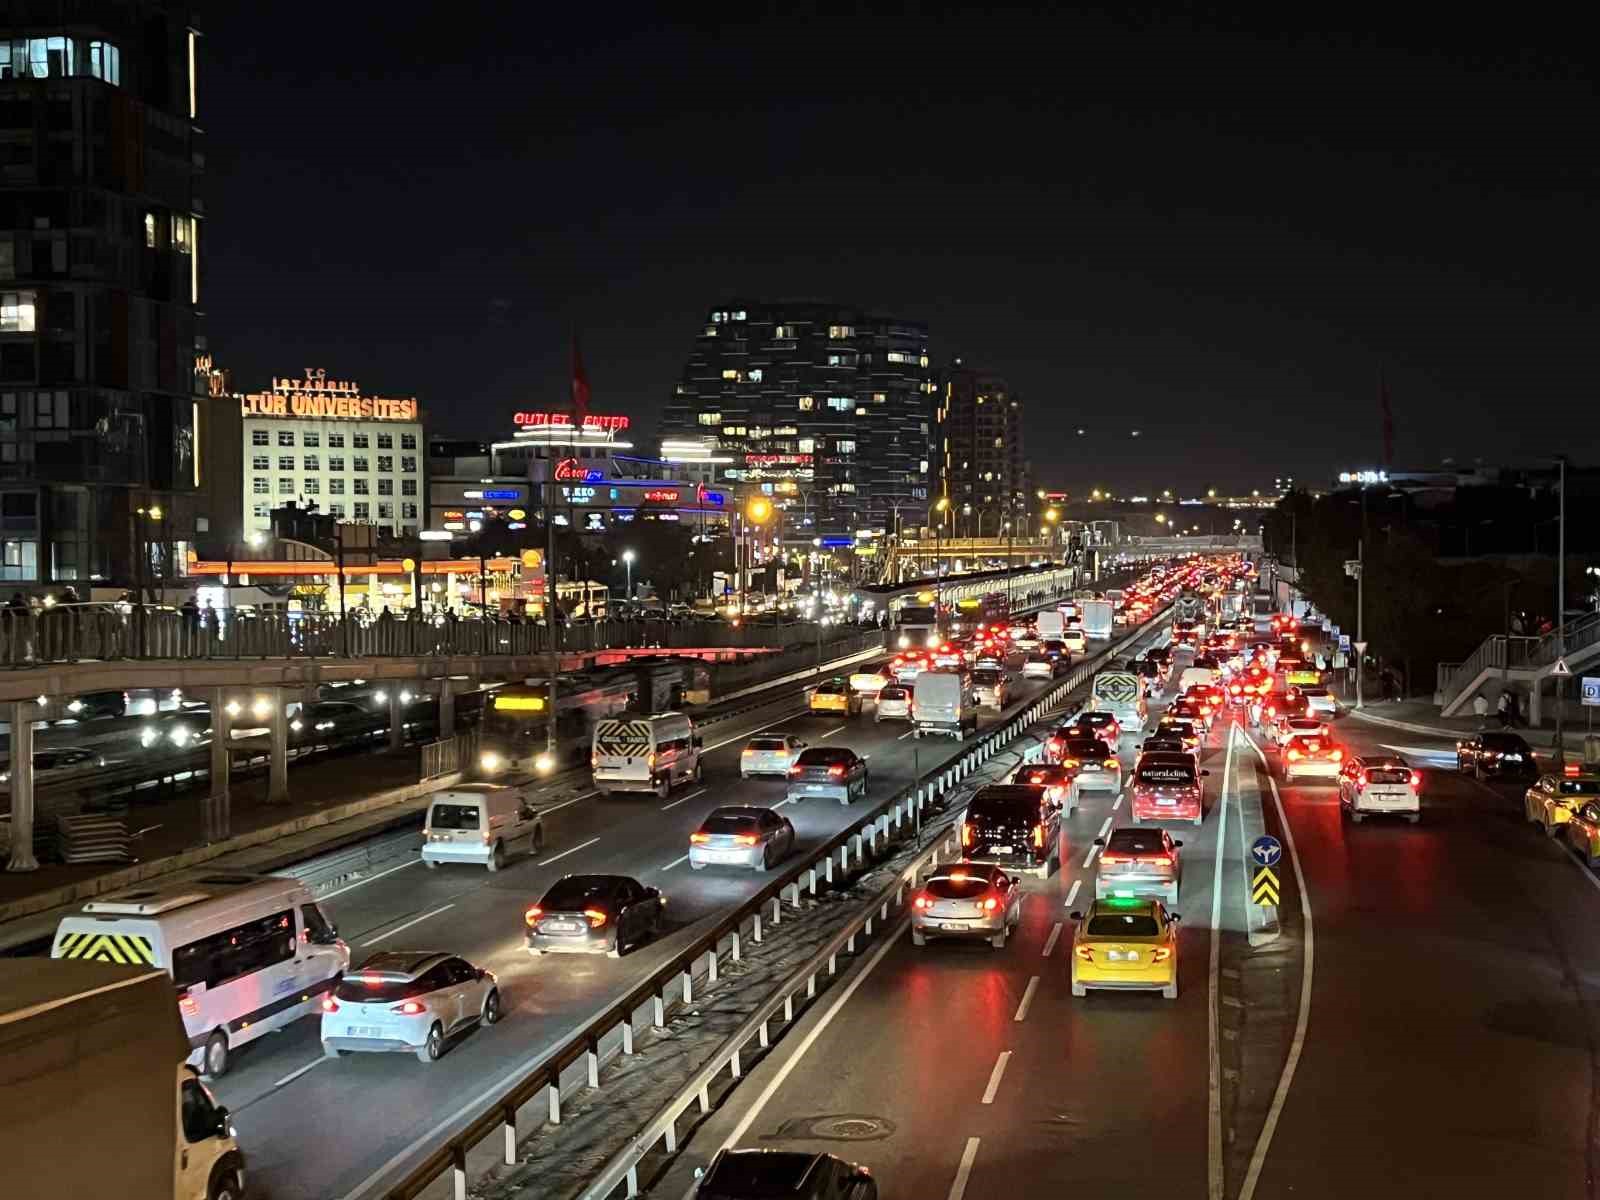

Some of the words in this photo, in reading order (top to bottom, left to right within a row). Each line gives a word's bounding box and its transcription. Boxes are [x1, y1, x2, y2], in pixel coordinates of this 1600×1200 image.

[513, 412, 570, 425] OUTLET
[583, 415, 629, 428] ENTER
[562, 487, 595, 497] VKKO
